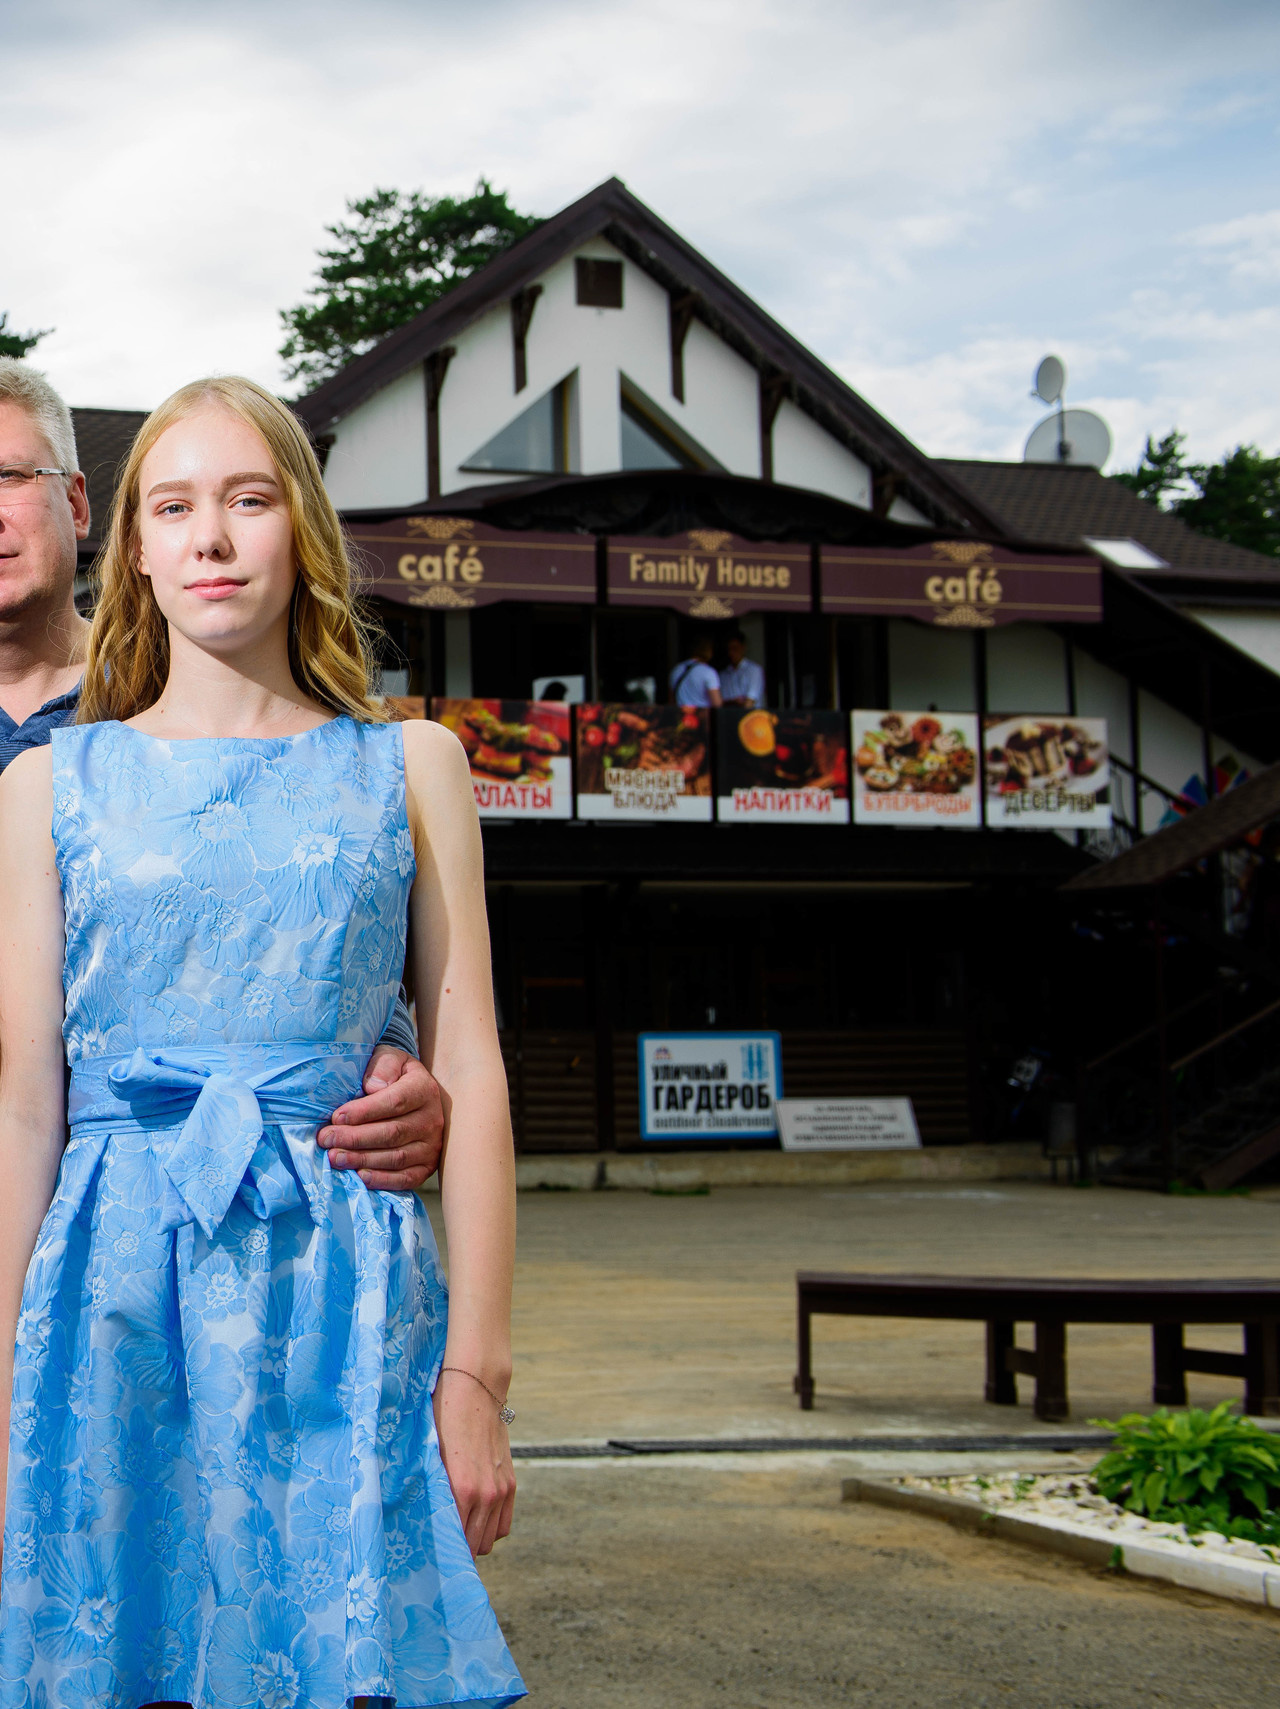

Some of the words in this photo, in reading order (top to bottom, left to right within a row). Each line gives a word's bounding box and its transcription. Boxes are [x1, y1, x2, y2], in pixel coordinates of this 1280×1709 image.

[397, 543, 485, 584] café
[629, 553, 710, 592] Family
[718, 557, 791, 588] House
[925, 565, 1002, 605] café
[606, 769, 685, 792] МЯСНЫЕ
[473, 782, 553, 811] АЛАТЫ
[612, 790, 678, 815] БЛЮДА
[733, 787, 832, 813] НАПИТКИ
[862, 791, 973, 816] БУТЕРБРОДЫ
[1003, 787, 1097, 817] ДЕСЕРТЫ
[651, 1060, 729, 1082] УЛИЧНЫЙ
[652, 1083, 771, 1113] ГАРДЕРОБ
